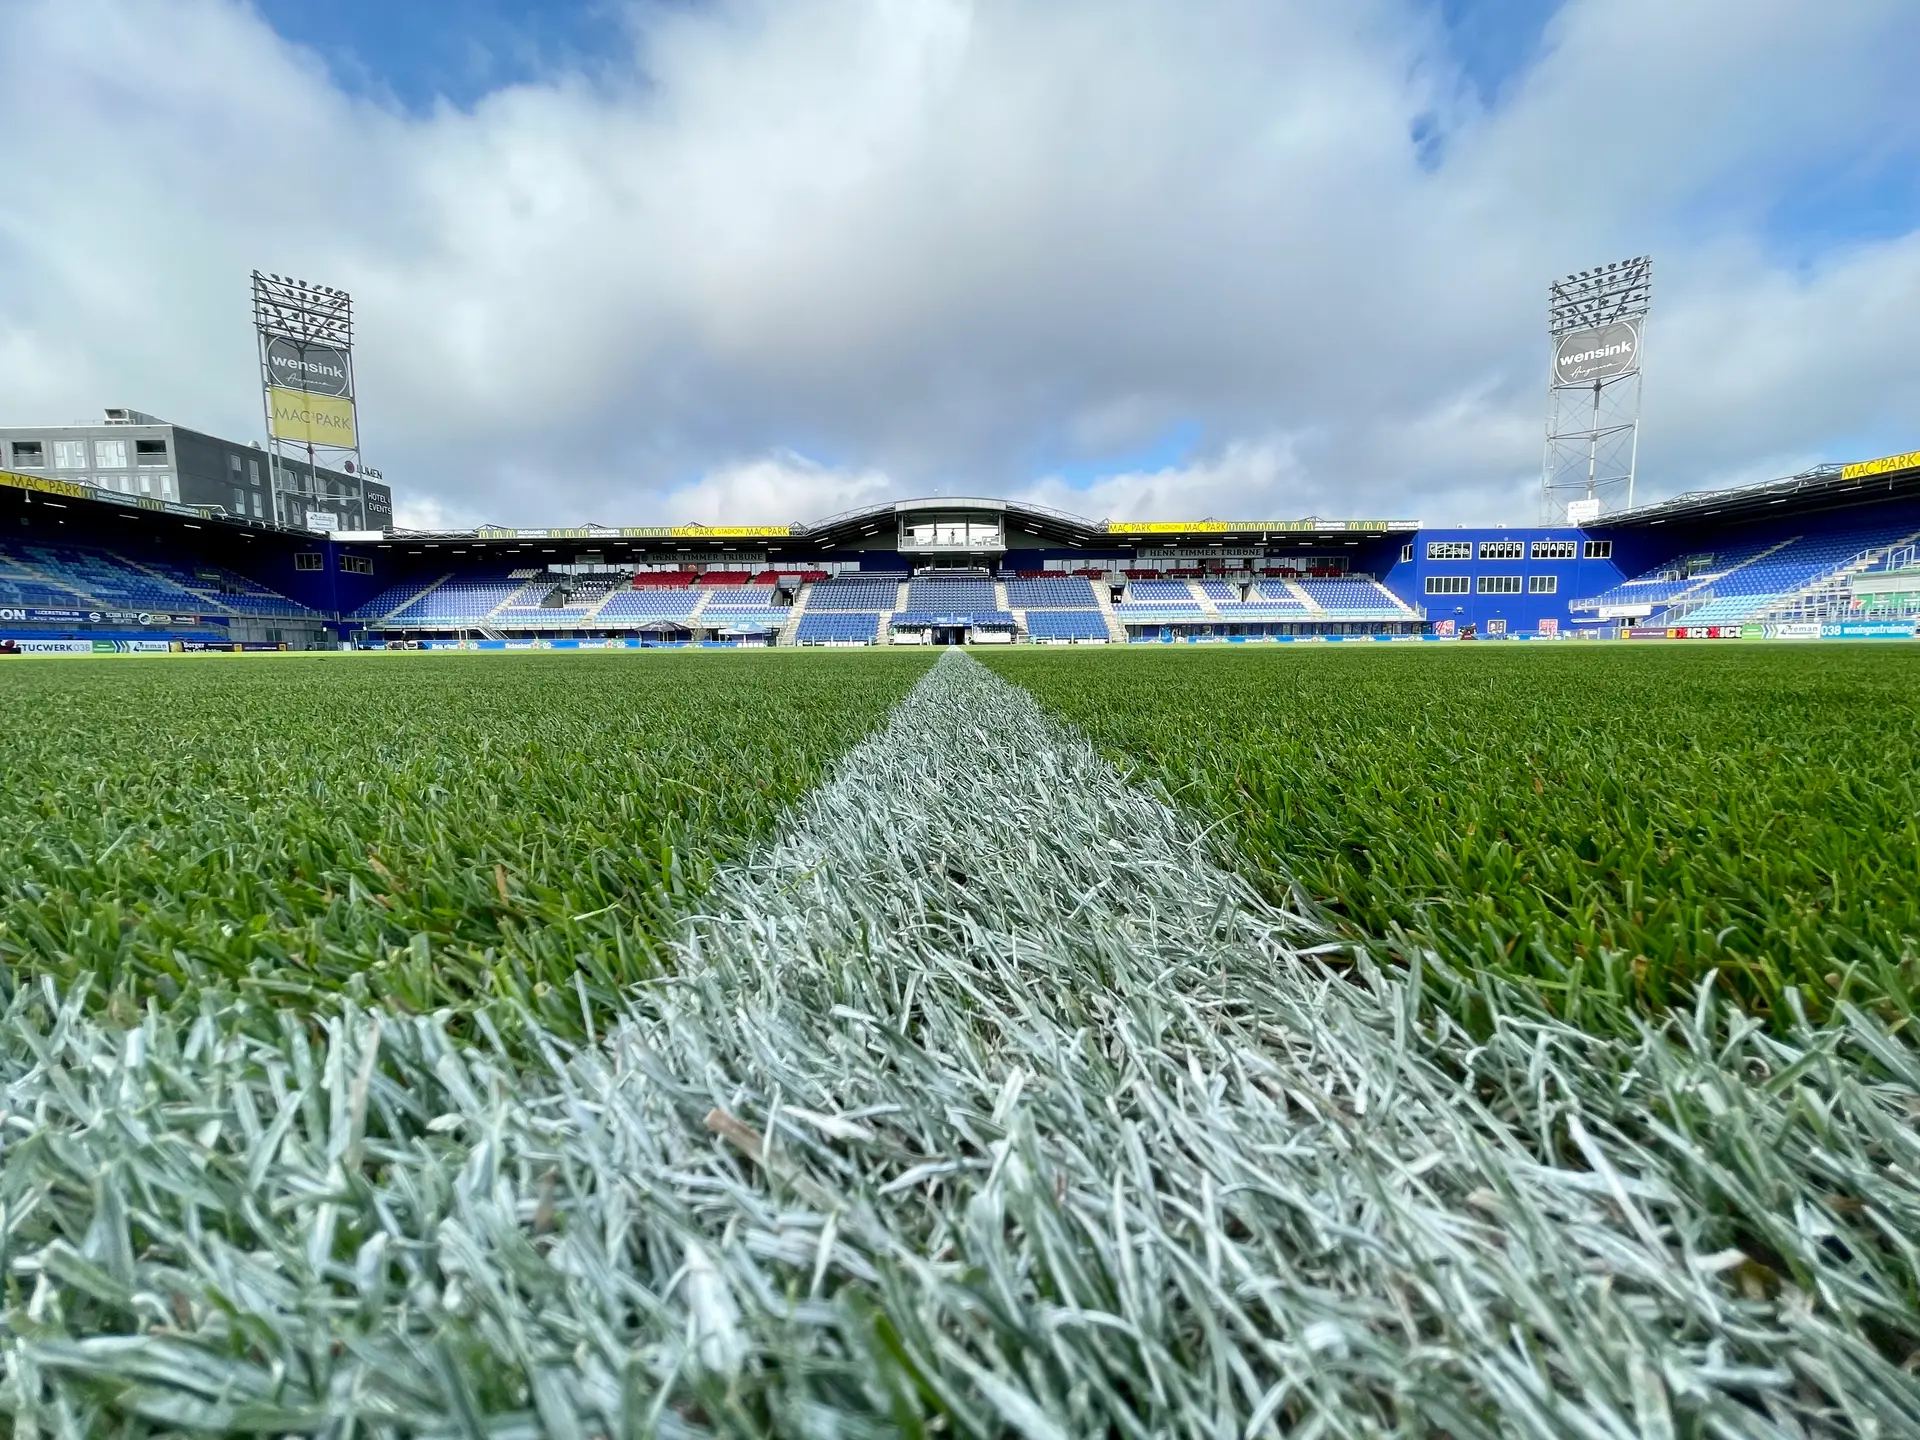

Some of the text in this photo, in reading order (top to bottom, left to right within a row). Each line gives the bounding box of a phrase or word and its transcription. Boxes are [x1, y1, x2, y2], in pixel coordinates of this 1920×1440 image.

[1560, 341, 1632, 366] wensink
[272, 355, 344, 379] wensink
[367, 492, 387, 503] HOTEL
[368, 503, 392, 515] EVENTS
[652, 553, 763, 561] HENK TIMMER TRIBUNE
[1150, 549, 1175, 557] HENK
[1179, 549, 1217, 557] TIMMER
[1821, 625, 1841, 636] 038
